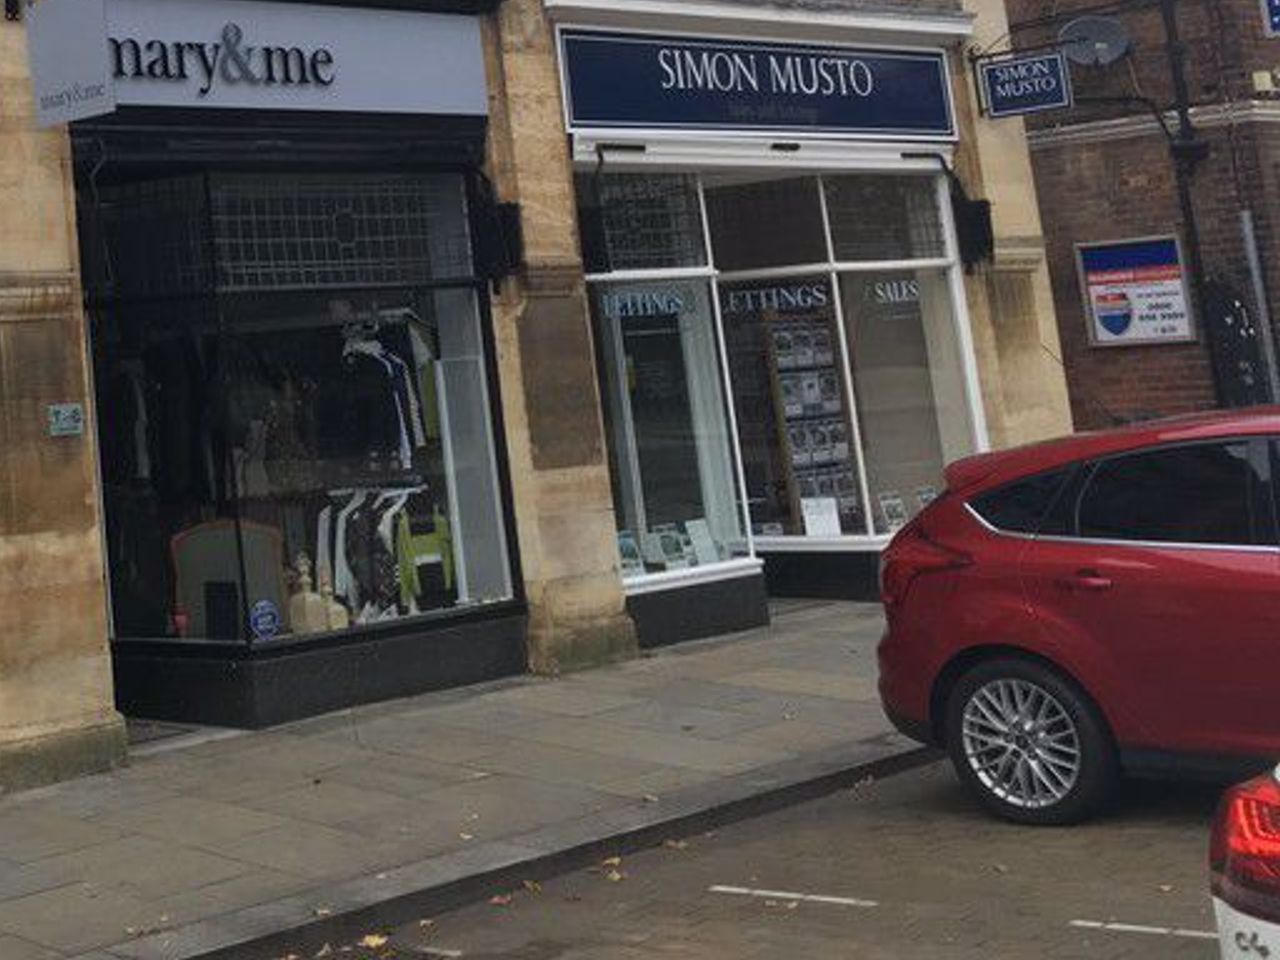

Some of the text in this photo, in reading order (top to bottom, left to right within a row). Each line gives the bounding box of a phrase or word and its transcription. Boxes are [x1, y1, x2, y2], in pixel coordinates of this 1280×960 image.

[658, 48, 872, 96] SIMON MUSTO
[995, 60, 1049, 82] SIMON
[996, 76, 1056, 97] MUSTO
[875, 281, 919, 303] SALES
